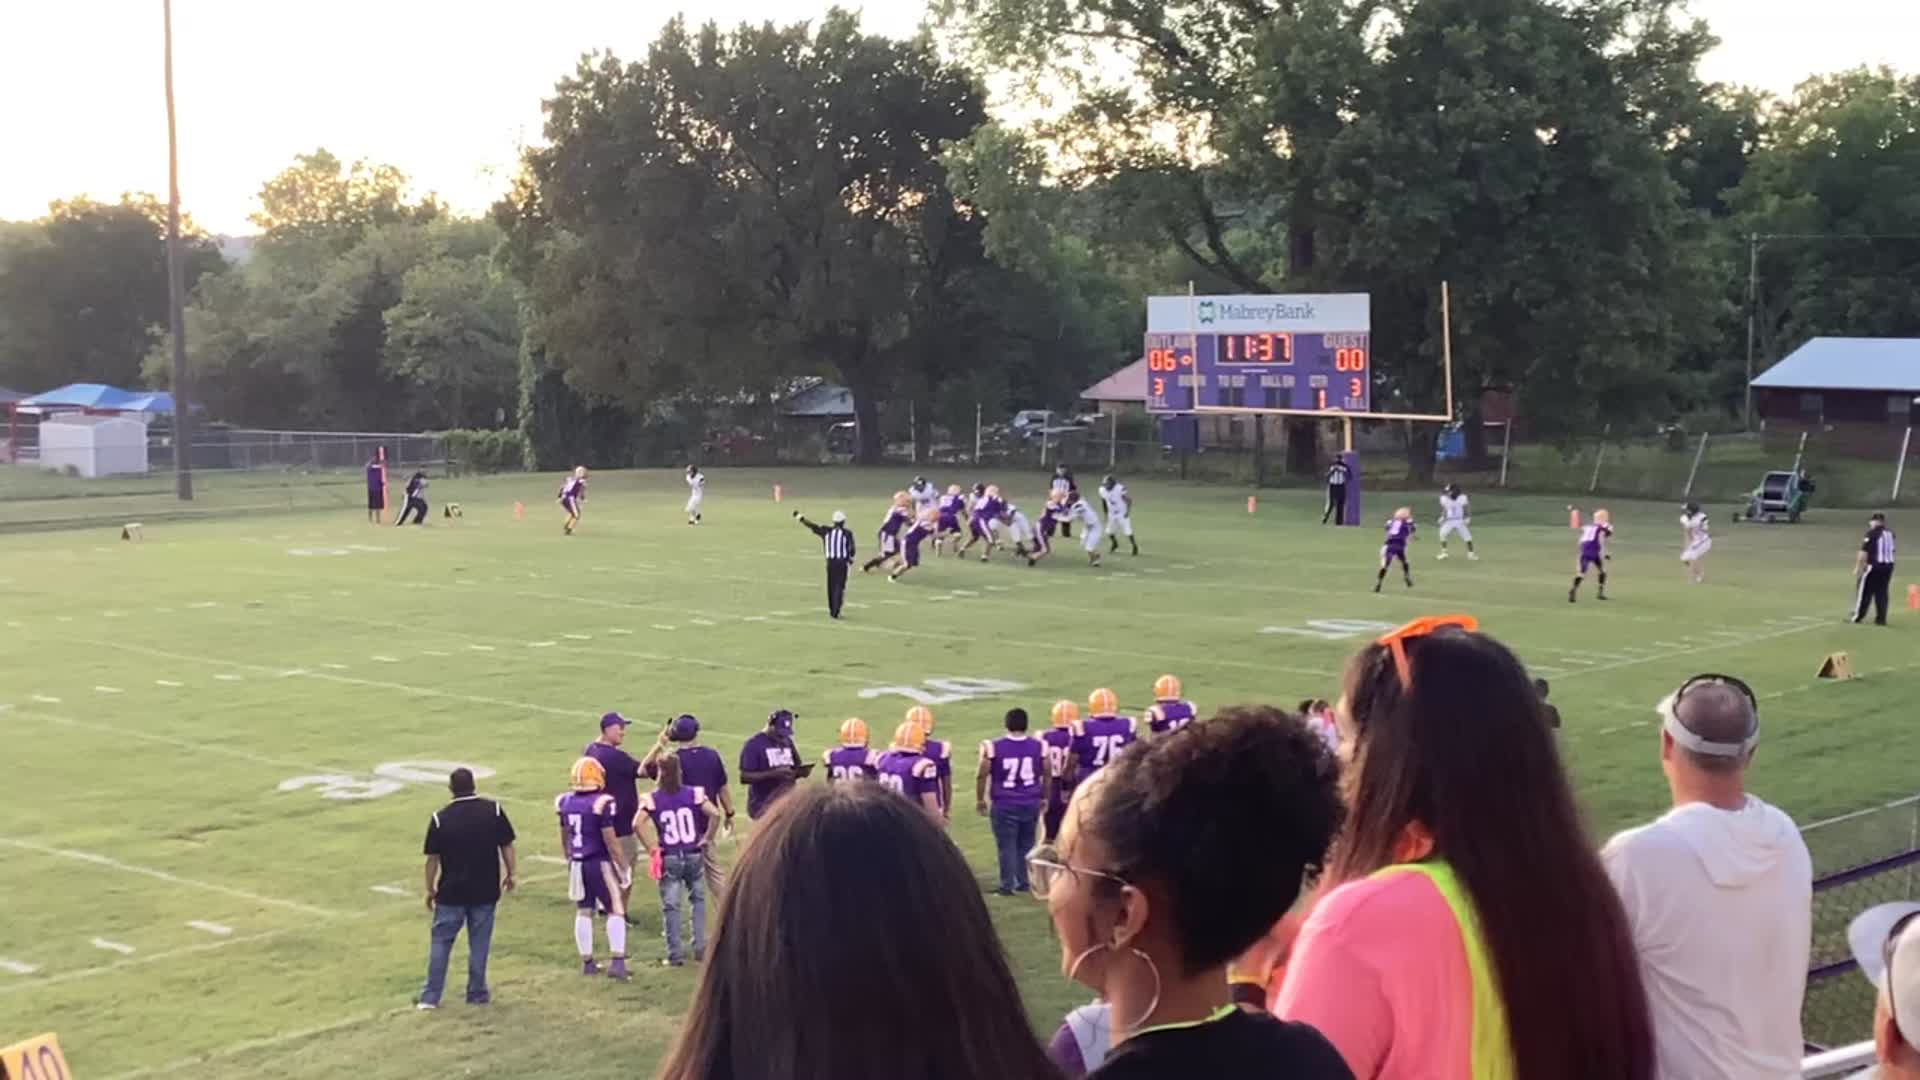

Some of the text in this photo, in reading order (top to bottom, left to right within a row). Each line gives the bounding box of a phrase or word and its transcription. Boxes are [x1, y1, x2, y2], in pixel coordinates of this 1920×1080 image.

[1220, 304, 1315, 322] MabreyBank
[1226, 334, 1291, 360] 11:37
[1150, 350, 1176, 372] 06
[1336, 348, 1364, 372] 00
[1153, 378, 1165, 396] 3
[1319, 389, 1326, 409] 1
[1350, 377, 1361, 397] 3
[857, 677, 1029, 704] 20
[278, 761, 496, 799] 30
[1003, 756, 1035, 788] 74
[568, 814, 583, 848] 7
[660, 807, 696, 845] 30
